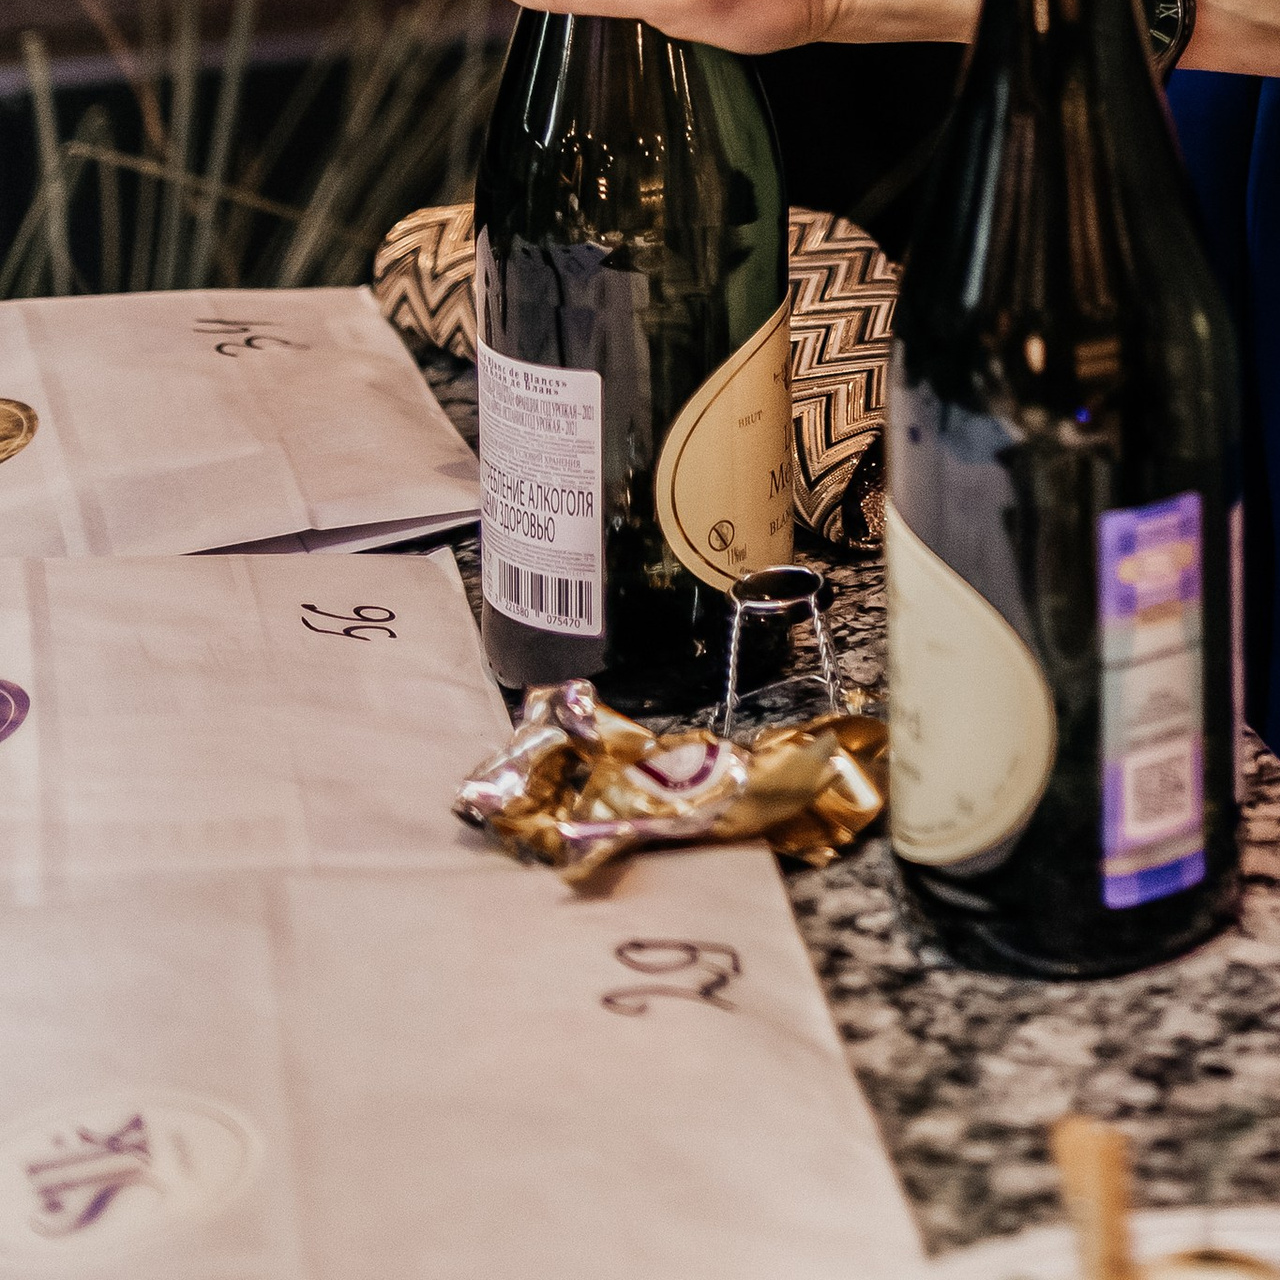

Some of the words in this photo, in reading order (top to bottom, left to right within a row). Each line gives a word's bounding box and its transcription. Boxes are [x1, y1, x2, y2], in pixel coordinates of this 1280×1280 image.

[509, 368, 519, 379] de
[552, 402, 578, 421] УРОЖАЯ
[738, 409, 763, 428] BRUT
[536, 416, 561, 435] УРОЖАЯ
[545, 455, 582, 470] ХРАНЕНИЯ
[528, 483, 594, 519] АЛКОГОЛЯ
[500, 500, 556, 544] ЗДОРОВЬЮ
[301, 603, 398, 643] 56
[505, 599, 530, 619] 221580
[546, 614, 581, 629] 075470
[602, 937, 743, 1018] 29
